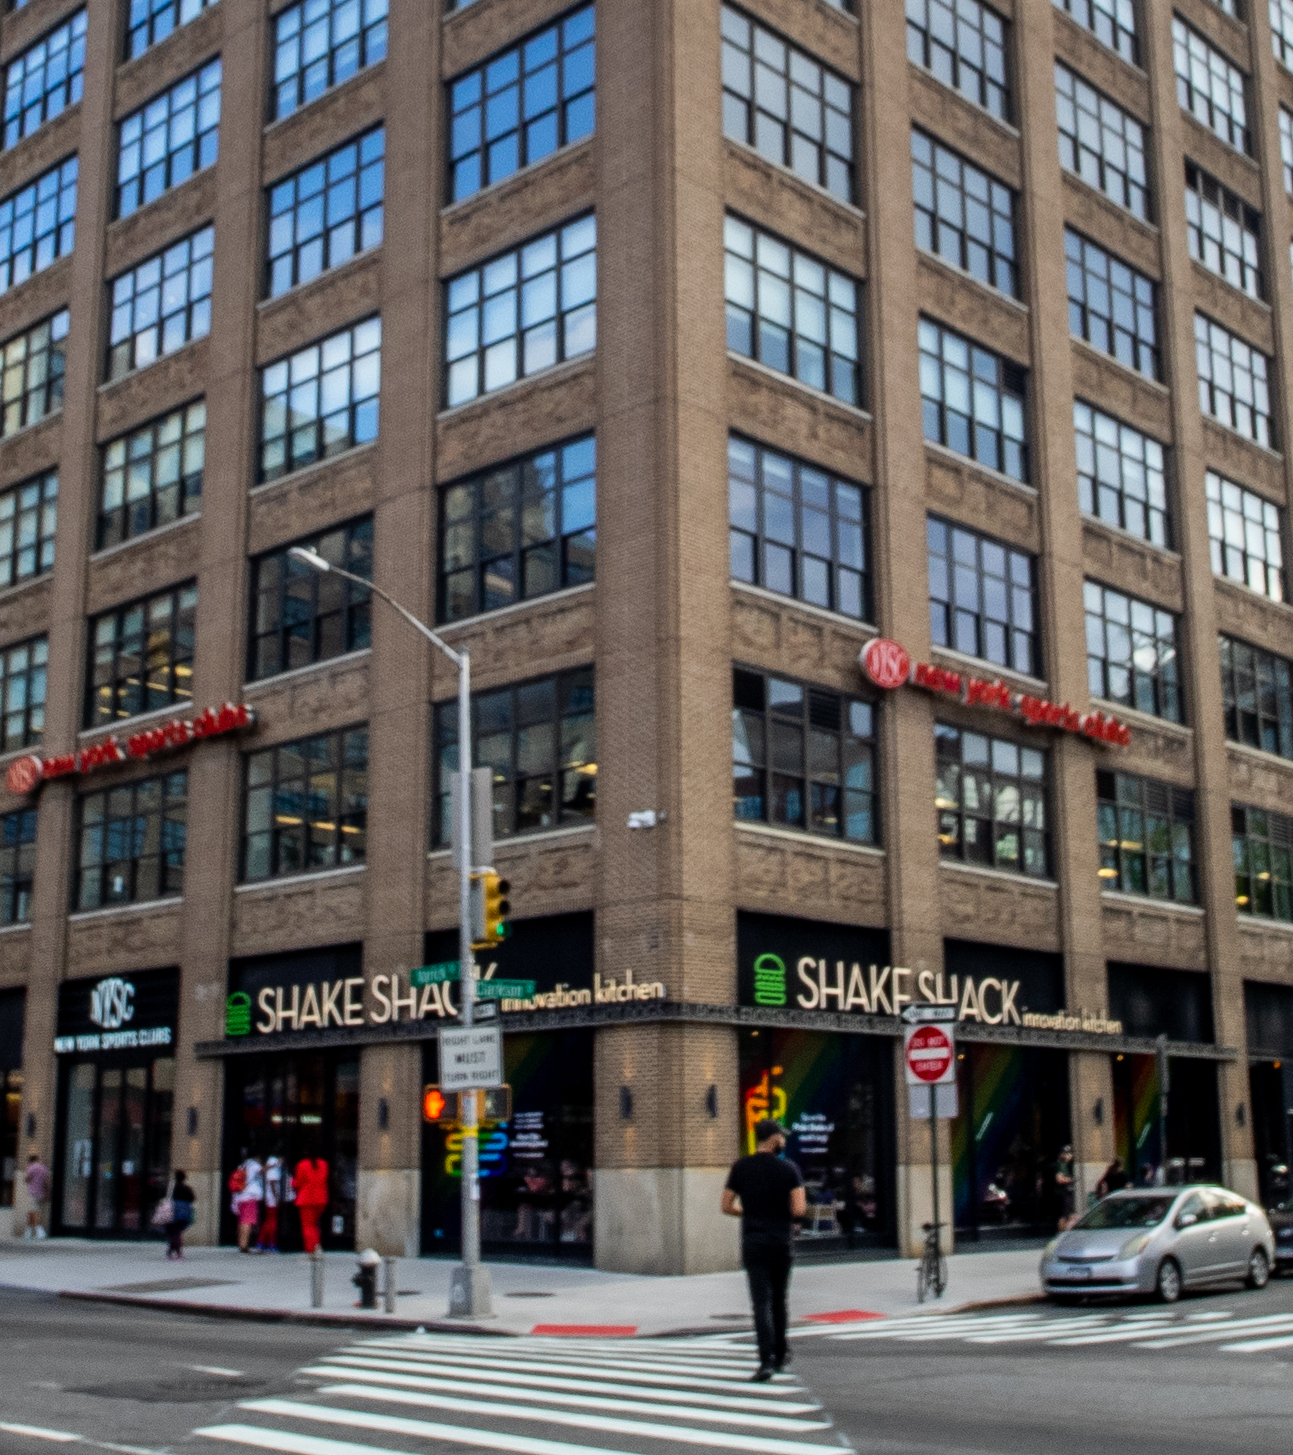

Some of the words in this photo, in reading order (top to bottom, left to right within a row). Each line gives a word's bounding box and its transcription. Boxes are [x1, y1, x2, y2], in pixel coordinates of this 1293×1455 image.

[257, 978, 365, 1034] SHAKE
[593, 968, 665, 1005] kitchen
[797, 957, 912, 1016] SHAKE
[917, 970, 1021, 1027] SHACK
[1081, 1007, 1123, 1035] kitchen
